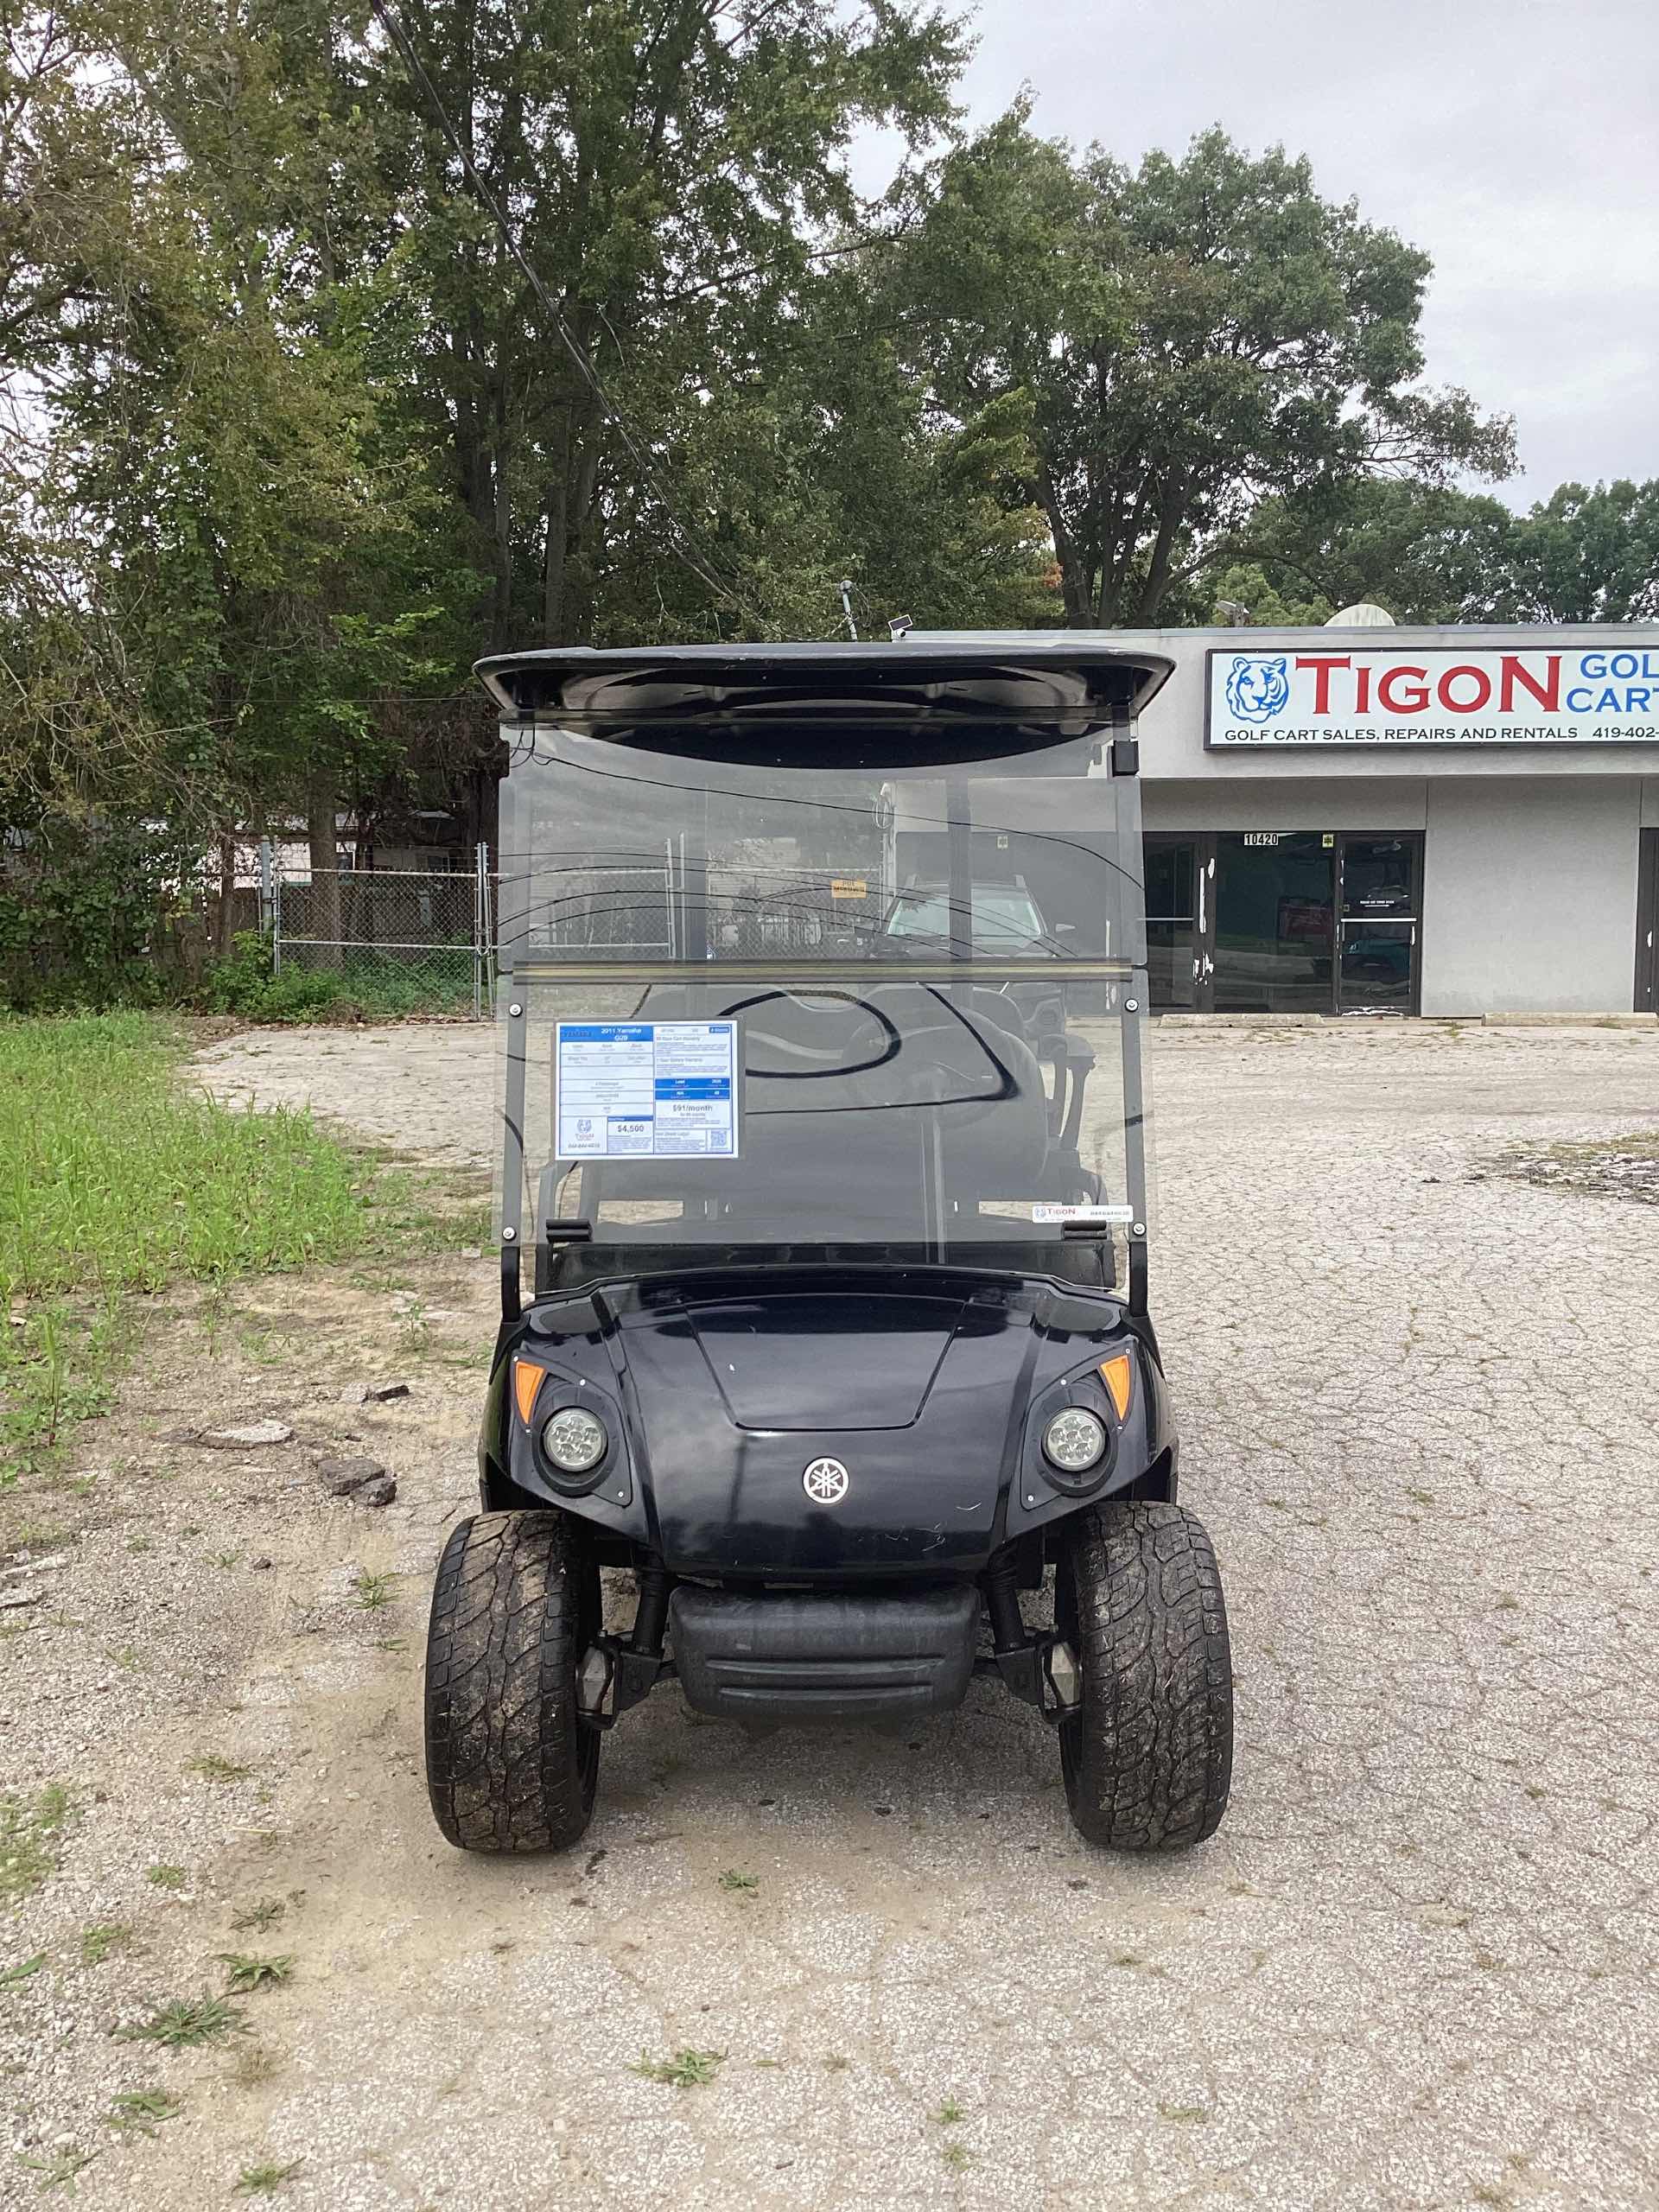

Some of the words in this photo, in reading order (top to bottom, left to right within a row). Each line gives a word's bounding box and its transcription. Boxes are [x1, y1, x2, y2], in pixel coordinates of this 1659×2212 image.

[1580, 653, 1659, 679] GOL
[1295, 655, 1563, 715] TIGON
[1225, 729, 1270, 741] GOLF
[1274, 729, 1319, 741] CART
[1322, 728, 1380, 741] SALES,
[1384, 728, 1456, 740] REPAIRS
[1459, 728, 1497, 740] AND
[1502, 727, 1578, 739] RENTALS
[1245, 833, 1278, 845] 10420
[672, 1103, 713, 1113] $91/month
[617, 1124, 645, 1134] $4,500
